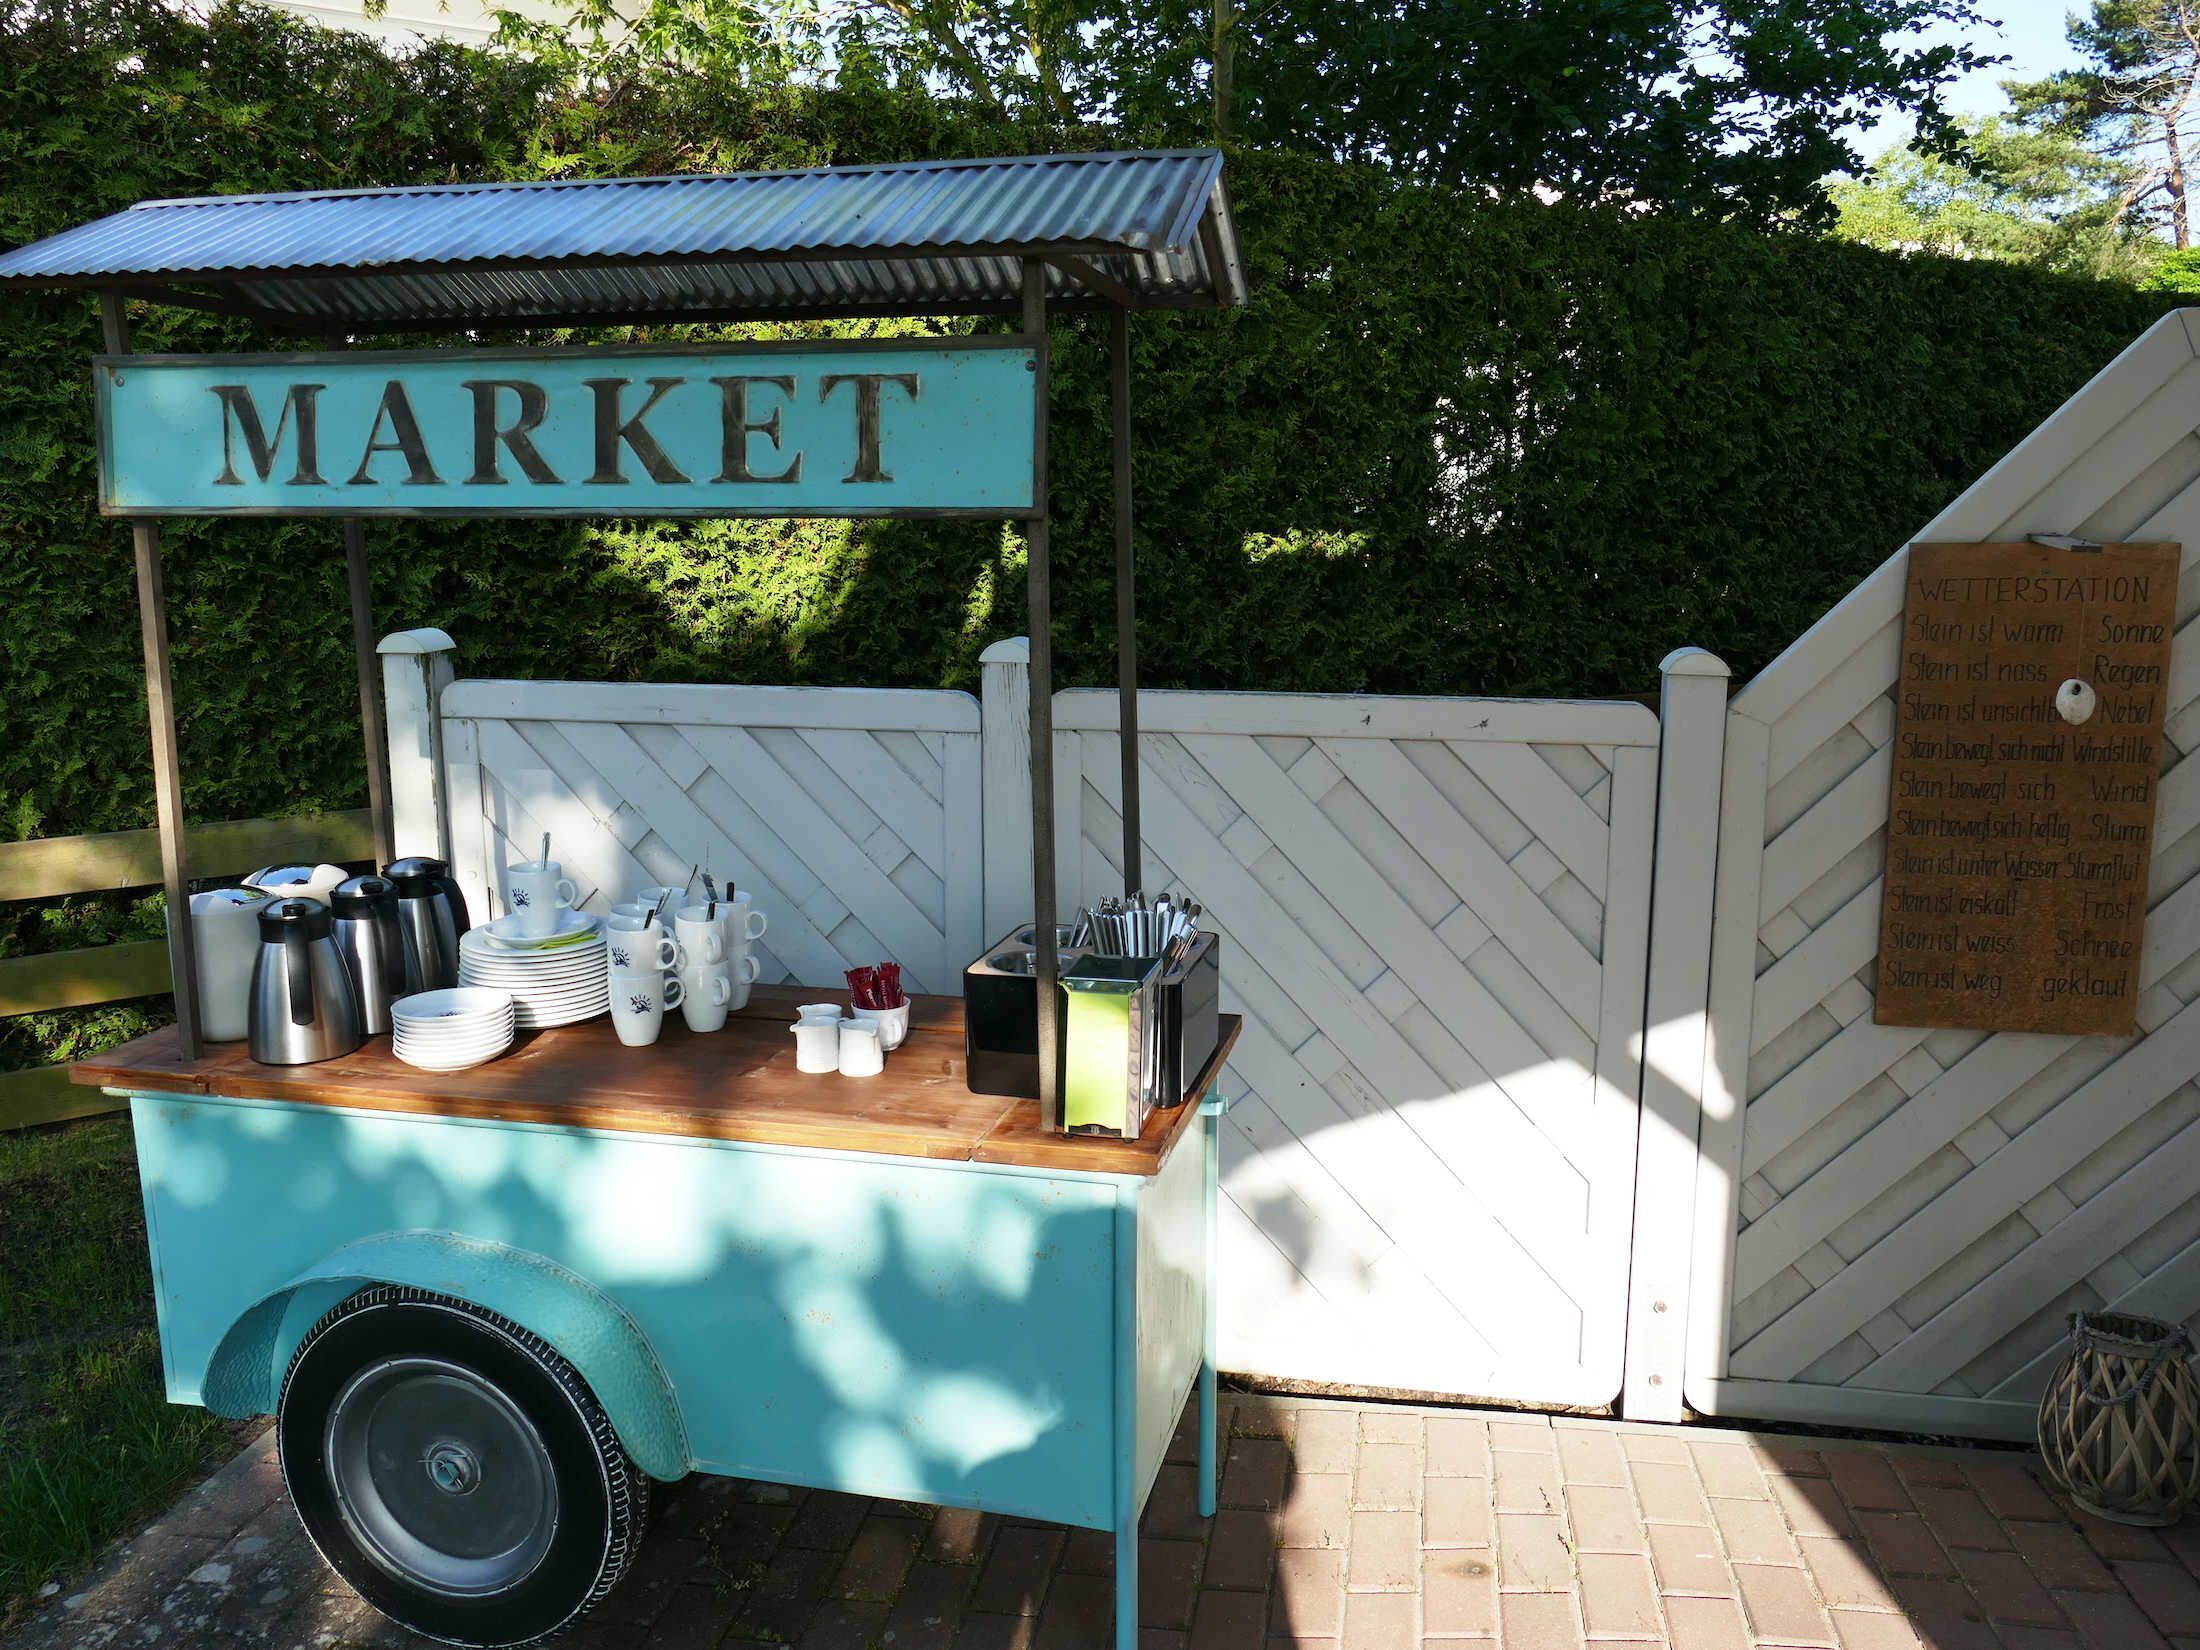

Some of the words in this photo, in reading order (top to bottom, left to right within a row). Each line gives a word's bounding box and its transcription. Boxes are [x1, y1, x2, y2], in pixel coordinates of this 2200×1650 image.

[209, 373, 921, 486] MARKET
[1918, 576, 2150, 603] WETTERSTATION
[1910, 614, 1962, 642] Stein
[1970, 616, 1993, 642] ist
[2002, 623, 2064, 643] warm
[2098, 615, 2165, 643] Sonne
[1908, 652, 1959, 681] Stein
[1966, 654, 1988, 681] ist
[1998, 662, 2048, 682] nass
[2093, 654, 2160, 689] Regen
[1903, 693, 1949, 722] Stein
[1957, 694, 1976, 722] ist
[1983, 695, 2063, 724] unsichtb
[2100, 697, 2154, 725] Nebel
[1901, 732, 1943, 761] Stein
[1945, 733, 1994, 766] bewegt
[1999, 735, 2030, 762] sich
[2073, 736, 2152, 764] Windstille
[1898, 770, 1942, 798] Stein
[1949, 773, 2006, 804] bewegt
[2016, 776, 2055, 801] sich
[2091, 775, 2149, 802] Wind
[1896, 810, 1937, 837] Stein
[1939, 811, 1992, 842] bewegt
[1993, 813, 2022, 839] sich
[2029, 813, 2071, 846] heftig
[2089, 814, 2146, 842] Sturm
[1894, 848, 1933, 873] Stein
[1938, 849, 1954, 874] ist
[1958, 851, 2000, 875] unter
[2003, 850, 2059, 877] Wasser
[2064, 853, 2141, 885] Sturmflut
[1889, 886, 1931, 913] Stein
[1934, 887, 1952, 914] ist
[1959, 889, 2018, 917] eiskalt
[2082, 891, 2136, 921] Frost
[1887, 923, 1934, 951] Stein
[1936, 925, 1958, 952] ist
[1966, 934, 2017, 954] weiss
[2054, 929, 2134, 959] Schnee
[1885, 961, 1929, 988] Stein
[1933, 964, 1955, 991] ist
[1963, 973, 2003, 999] weg
[2040, 969, 2128, 1001] geklaut
